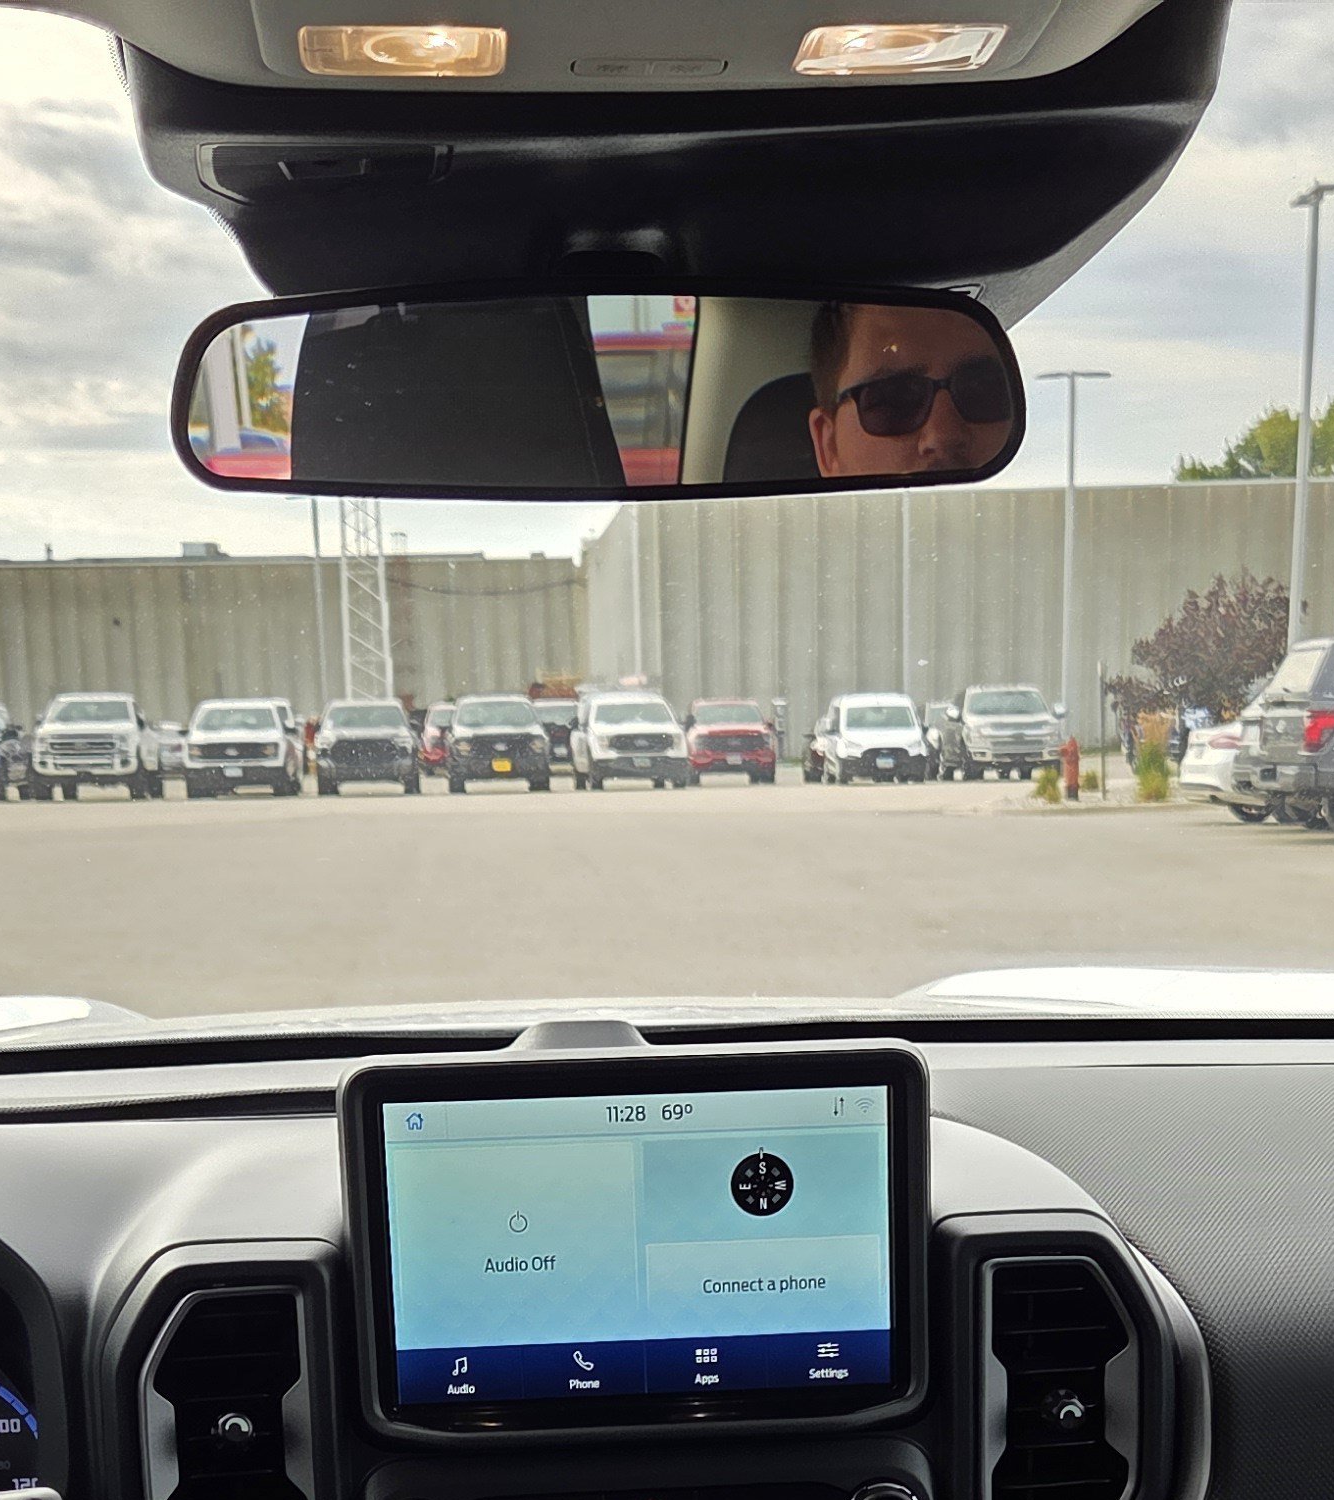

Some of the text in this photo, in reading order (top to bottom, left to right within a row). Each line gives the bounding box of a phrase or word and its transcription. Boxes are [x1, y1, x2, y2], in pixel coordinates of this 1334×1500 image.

[606, 1105, 646, 1123] 11:28
[759, 1162, 766, 1174] S
[759, 1198, 767, 1210] N
[484, 1254, 556, 1274] Audio Off
[702, 1274, 826, 1294] Connect a phone
[694, 1372, 720, 1386] Apps
[809, 1366, 849, 1381] Settings
[447, 1382, 476, 1395] Audio
[568, 1378, 600, 1391] Phone
